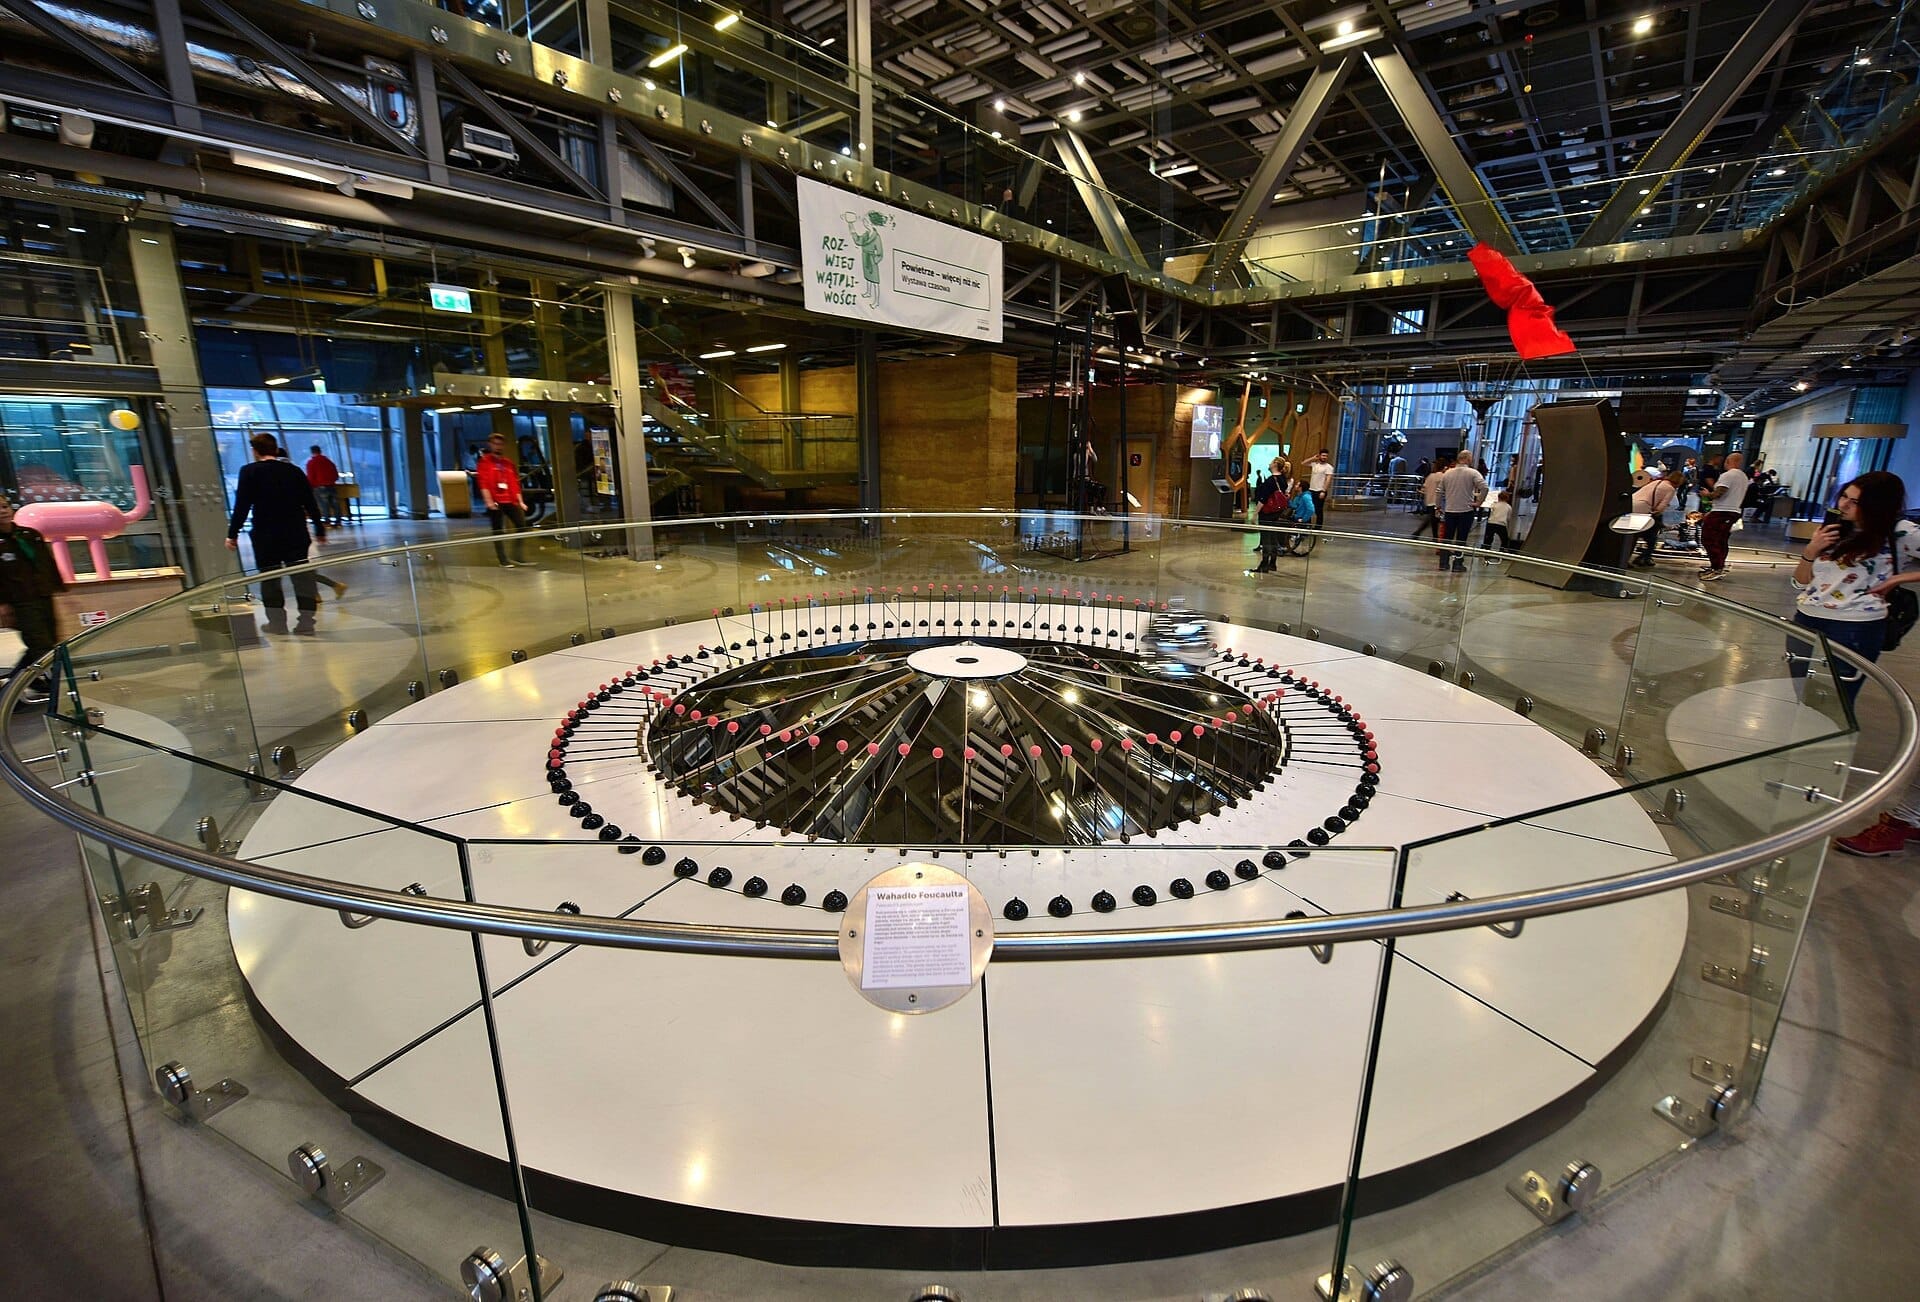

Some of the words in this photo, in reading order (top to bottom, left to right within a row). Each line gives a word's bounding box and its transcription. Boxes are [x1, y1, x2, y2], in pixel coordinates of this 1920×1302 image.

[822, 235, 848, 251] ROZ-
[825, 253, 855, 270] WIEJ
[816, 270, 859, 289] WĄTPLI-
[901, 260, 935, 277] Powietrze
[941, 271, 962, 286] więcej
[962, 276, 972, 287] niż
[972, 279, 981, 289] nic
[901, 274, 927, 287] Wystawa
[927, 282, 951, 293] czasowa
[823, 289, 857, 305] WOŚCI
[919, 890, 964, 899] Foucaulta
